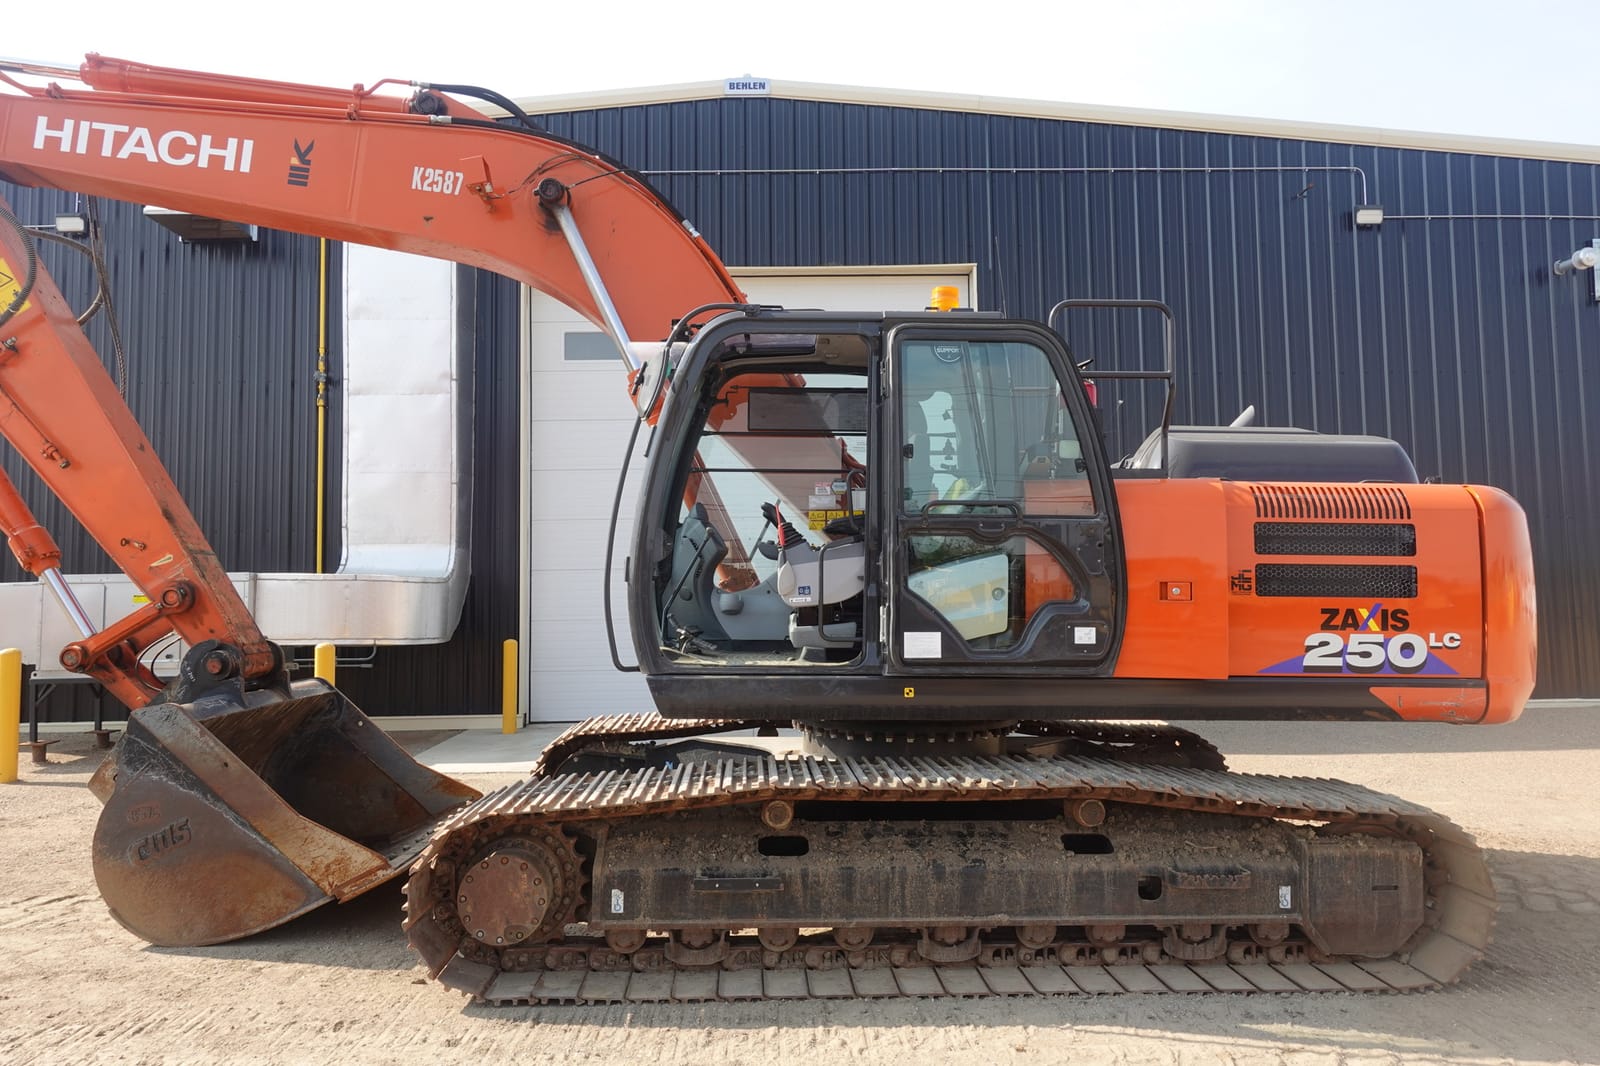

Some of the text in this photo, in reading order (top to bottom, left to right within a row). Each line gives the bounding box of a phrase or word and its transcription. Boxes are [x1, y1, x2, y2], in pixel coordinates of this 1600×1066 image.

[728, 82, 766, 90] BEHLEN
[33, 116, 254, 173] HITACHI
[411, 166, 464, 196] K2587
[1320, 603, 1410, 631] ZAXIS
[1303, 632, 1461, 674] 250 LC
